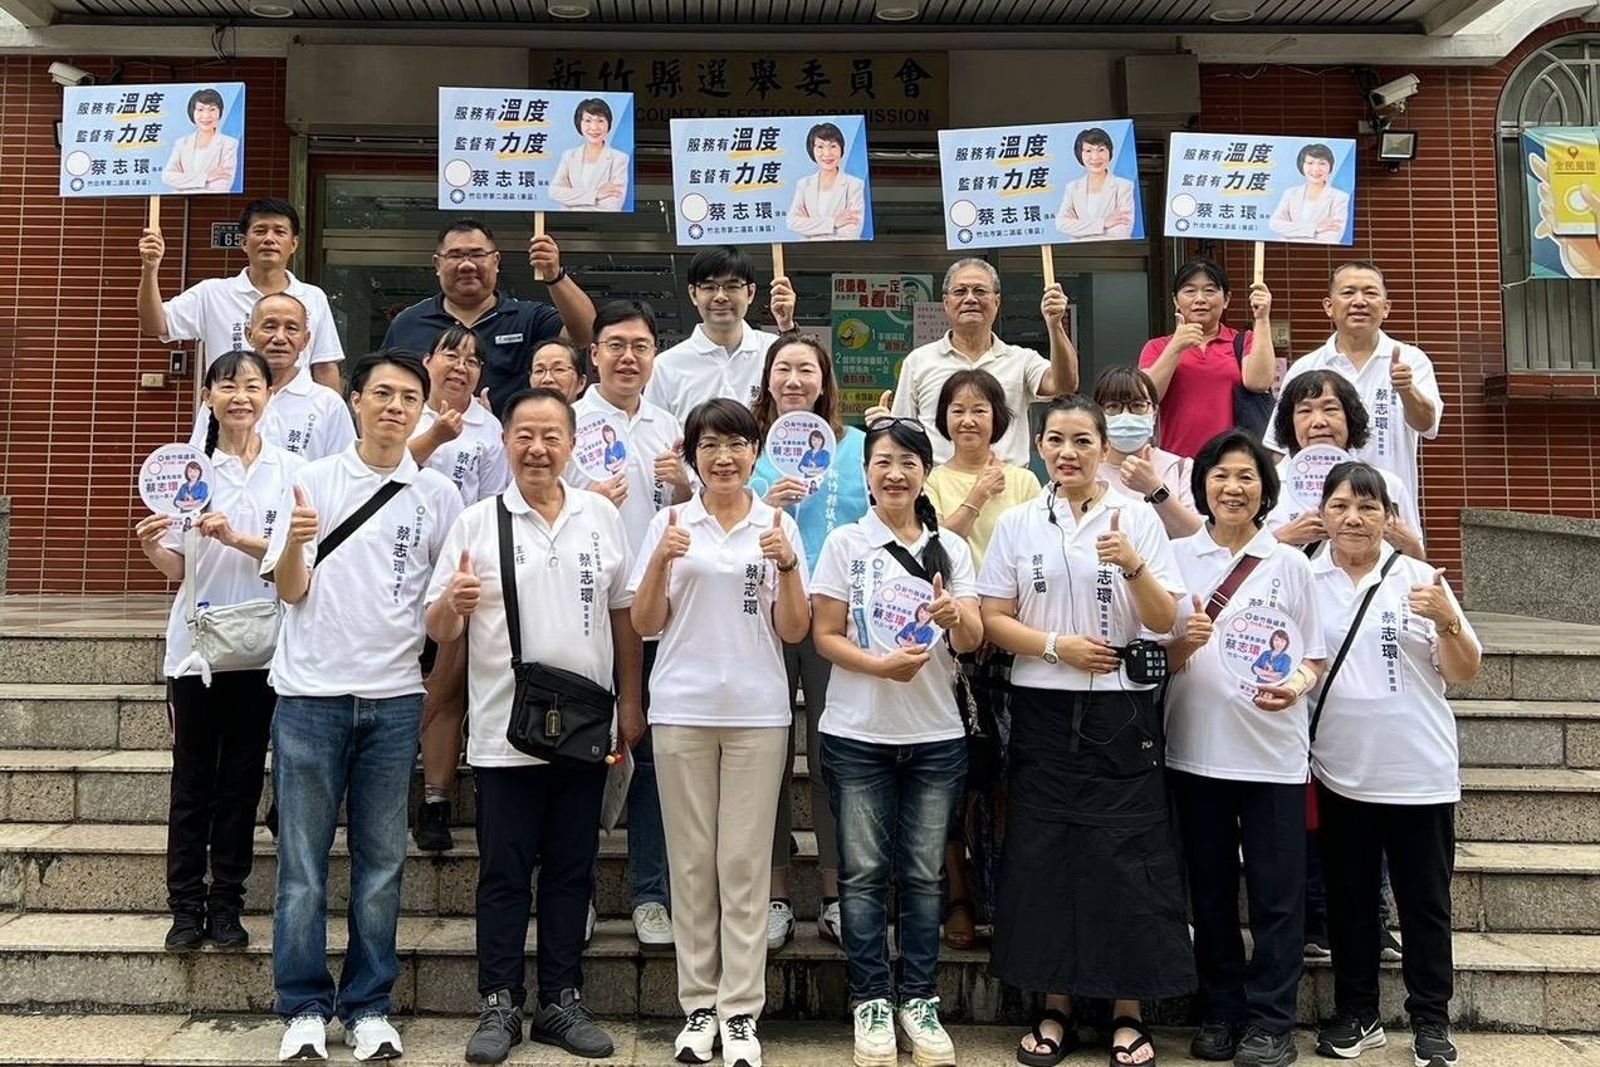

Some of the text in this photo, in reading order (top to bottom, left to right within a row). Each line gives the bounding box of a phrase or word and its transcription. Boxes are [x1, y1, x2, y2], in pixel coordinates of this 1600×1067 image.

[548, 58, 933, 99] 新竹縣選舉委員會
[91, 159, 150, 176] 蔡志環
[472, 170, 535, 187] 蔡志環
[709, 202, 773, 220] 蔡志環
[978, 206, 1041, 226] 蔡志環
[1197, 203, 1257, 220] 蔡志環
[744, 563, 758, 615] 蔡志環
